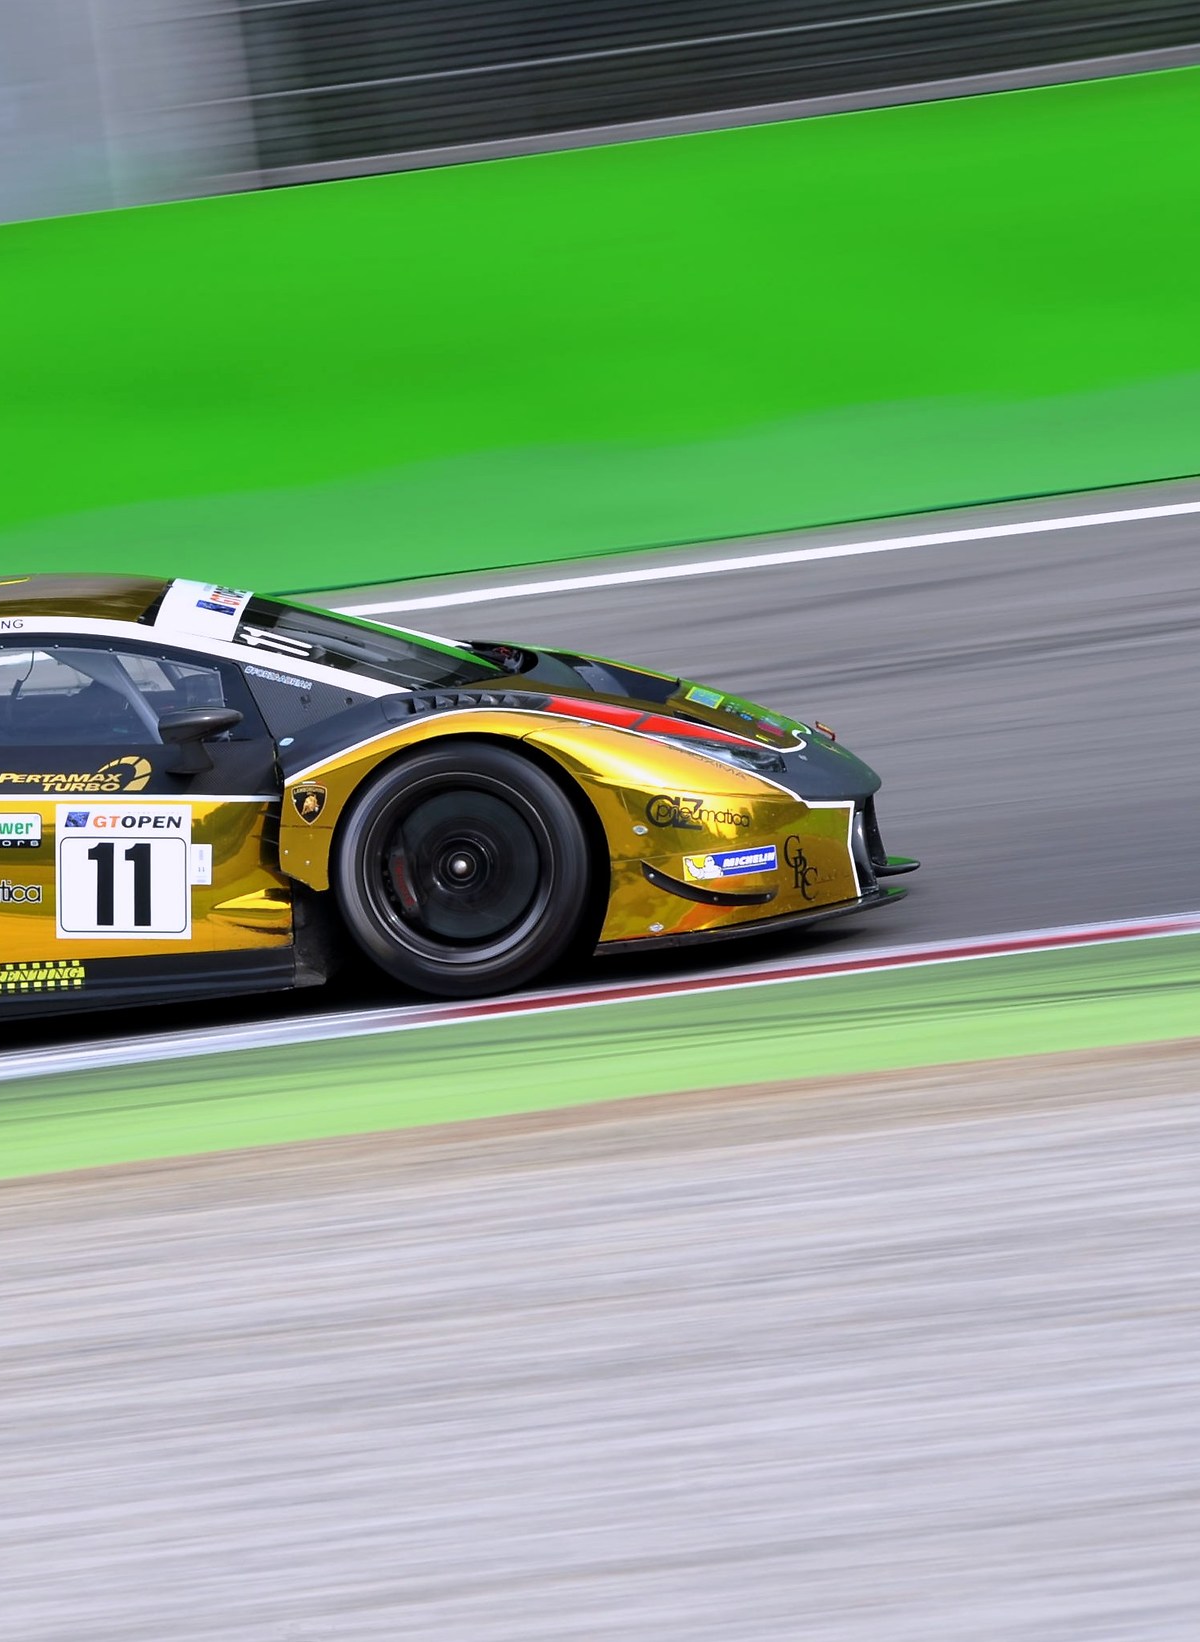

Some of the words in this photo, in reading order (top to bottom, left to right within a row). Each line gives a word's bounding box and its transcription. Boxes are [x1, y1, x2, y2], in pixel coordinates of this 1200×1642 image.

[42, 783, 121, 792] TURBO
[655, 803, 750, 828] pneumatica
[722, 852, 776, 867] MICHELIN
[87, 842, 152, 927] 11
